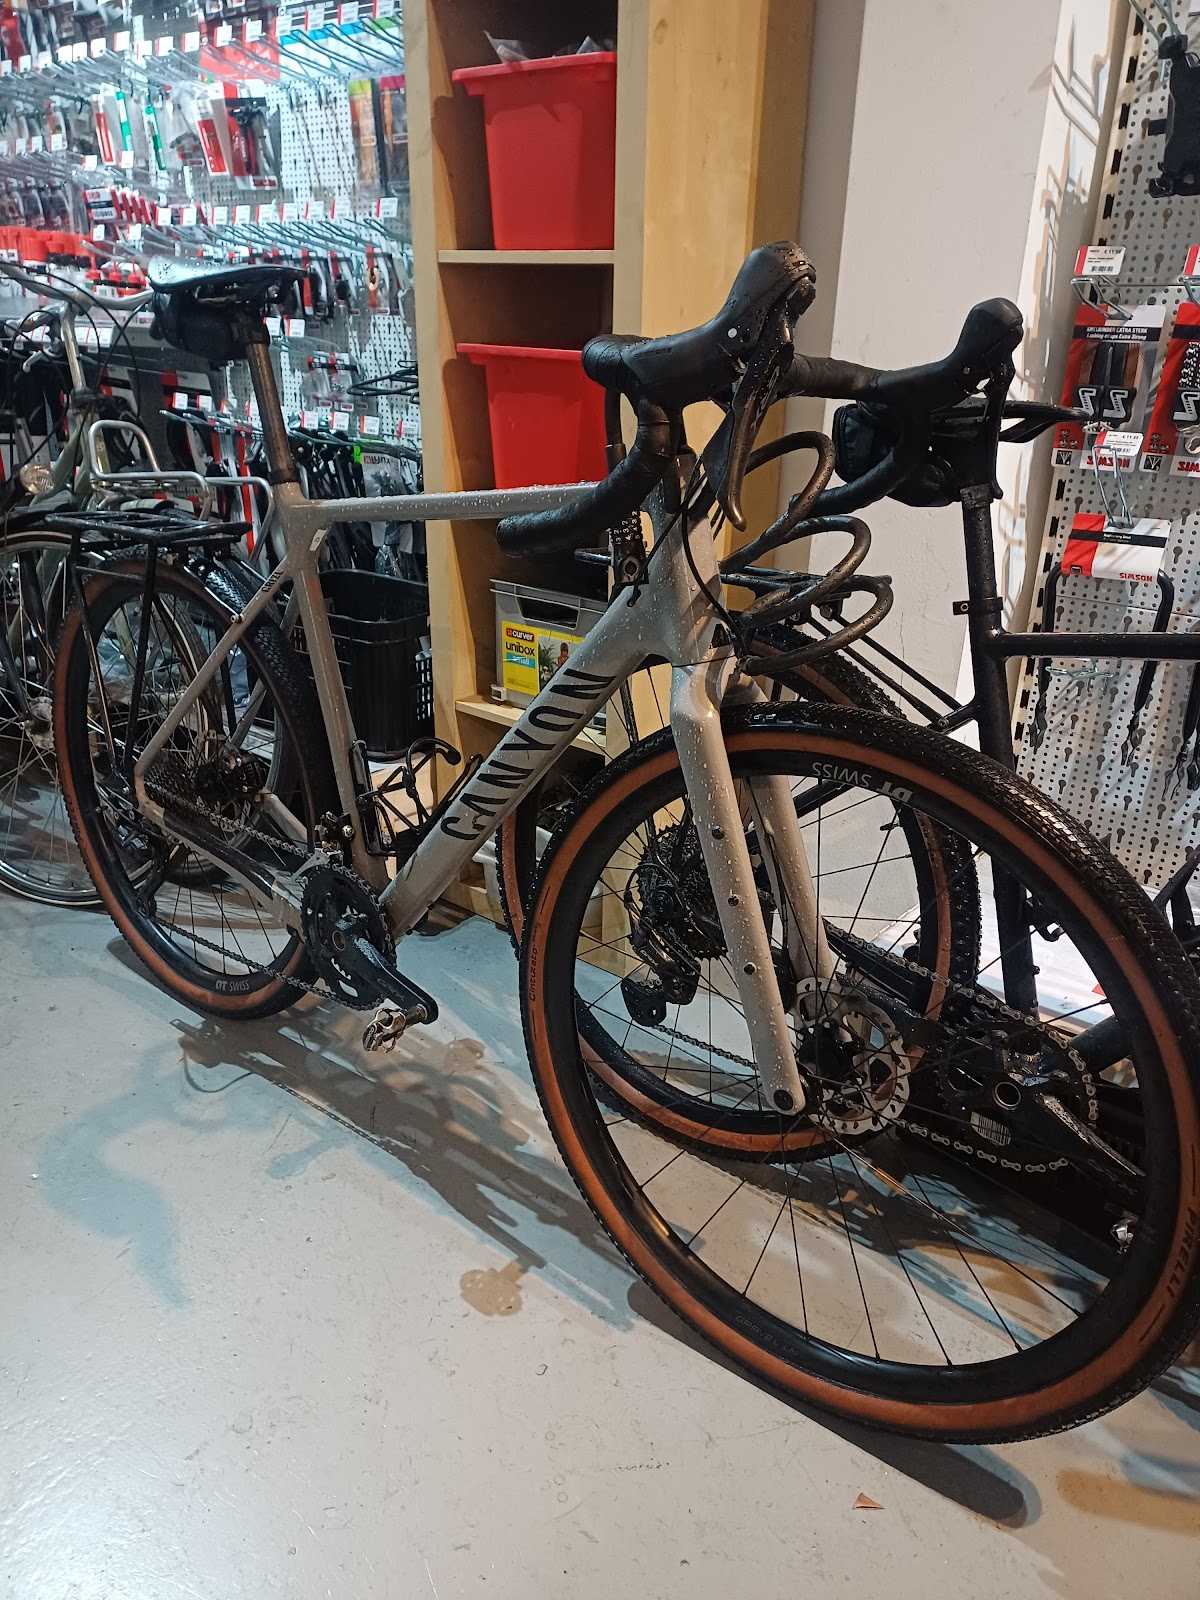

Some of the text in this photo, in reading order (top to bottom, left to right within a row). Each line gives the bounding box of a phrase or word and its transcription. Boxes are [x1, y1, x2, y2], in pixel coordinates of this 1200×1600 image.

[1086, 455, 1131, 468] SMSON
[1177, 461, 1200, 472] SIM
[1119, 572, 1153, 582] SIMSON
[512, 630, 534, 641] curver
[505, 641, 535, 656] unibox
[441, 668, 617, 841] CANYON
[811, 762, 914, 803] DT SWISS
[215, 979, 250, 992] DT SWISS
[1167, 1206, 1197, 1298] PIRELLI
